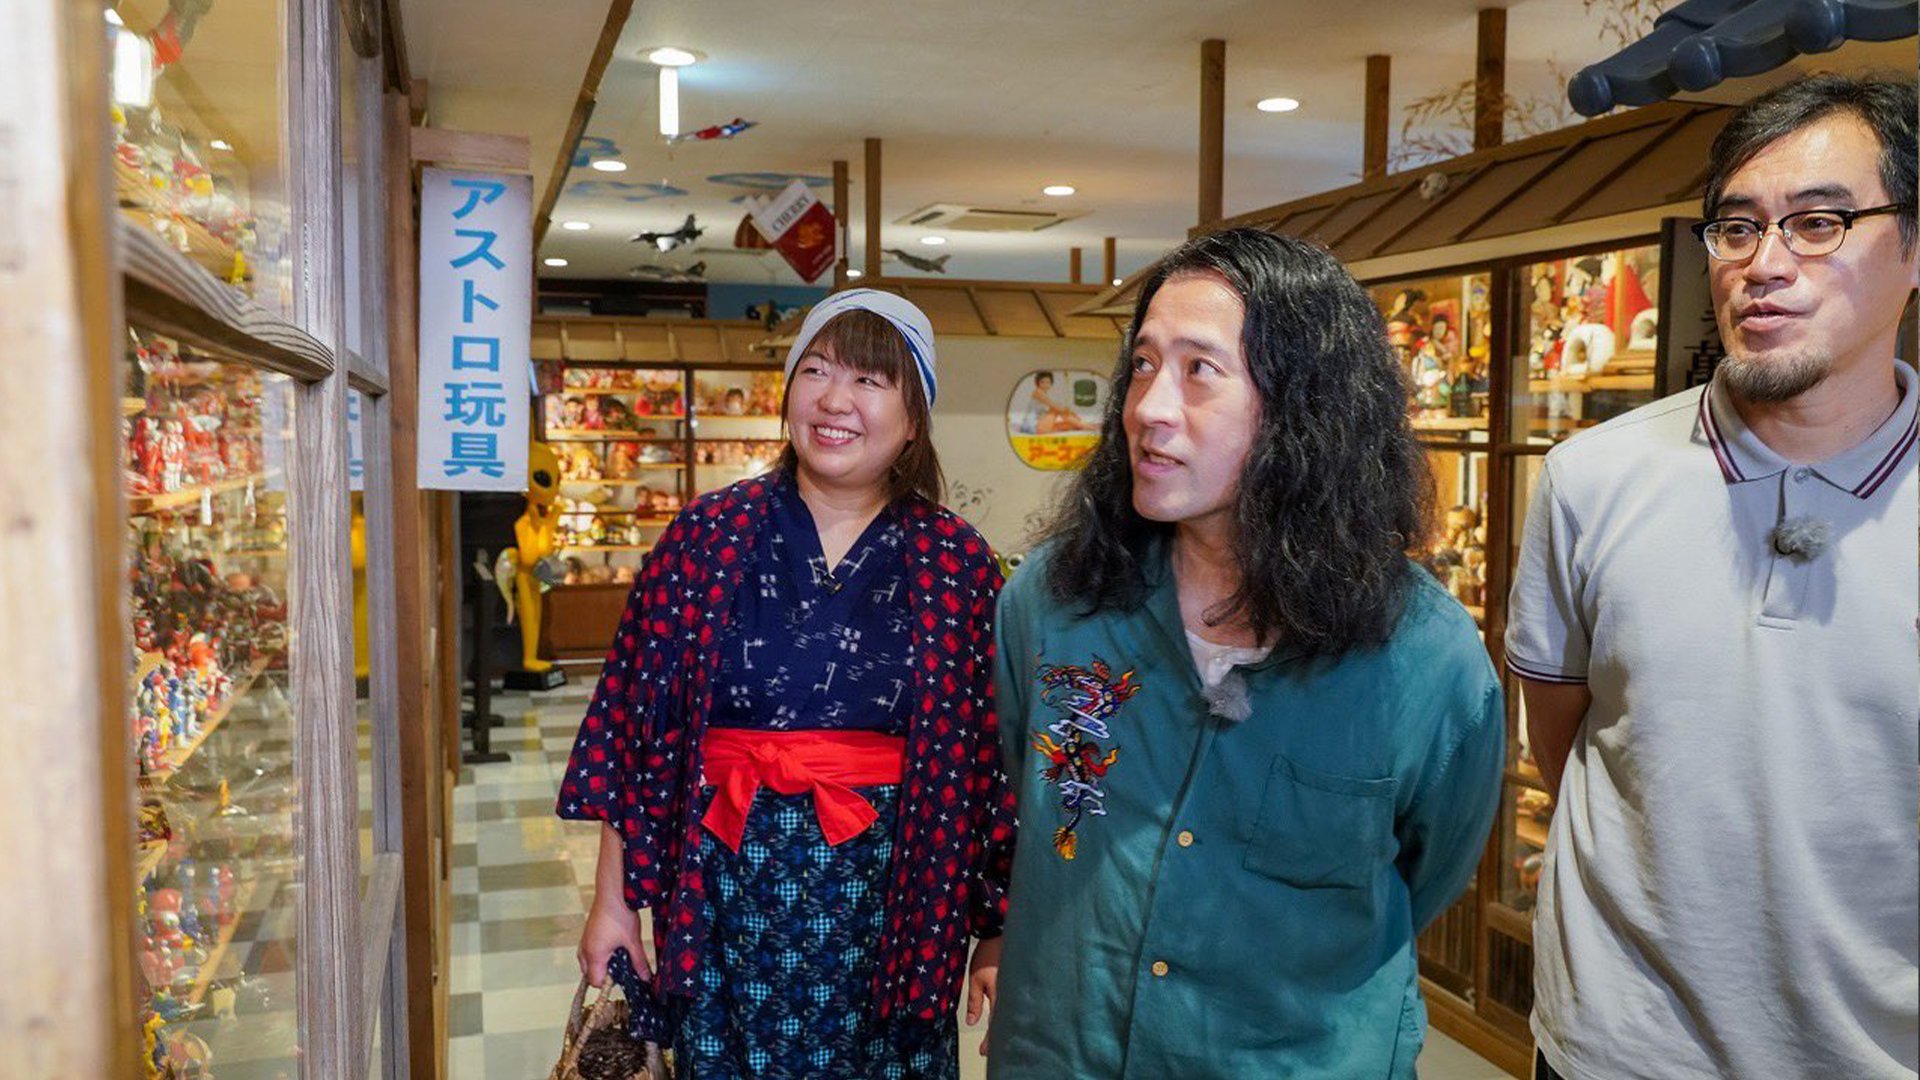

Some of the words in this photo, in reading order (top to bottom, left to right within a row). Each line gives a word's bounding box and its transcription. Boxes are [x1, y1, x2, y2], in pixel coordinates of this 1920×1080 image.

[771, 195, 810, 232] CHERRY
[443, 179, 506, 477] アストロ玩具
